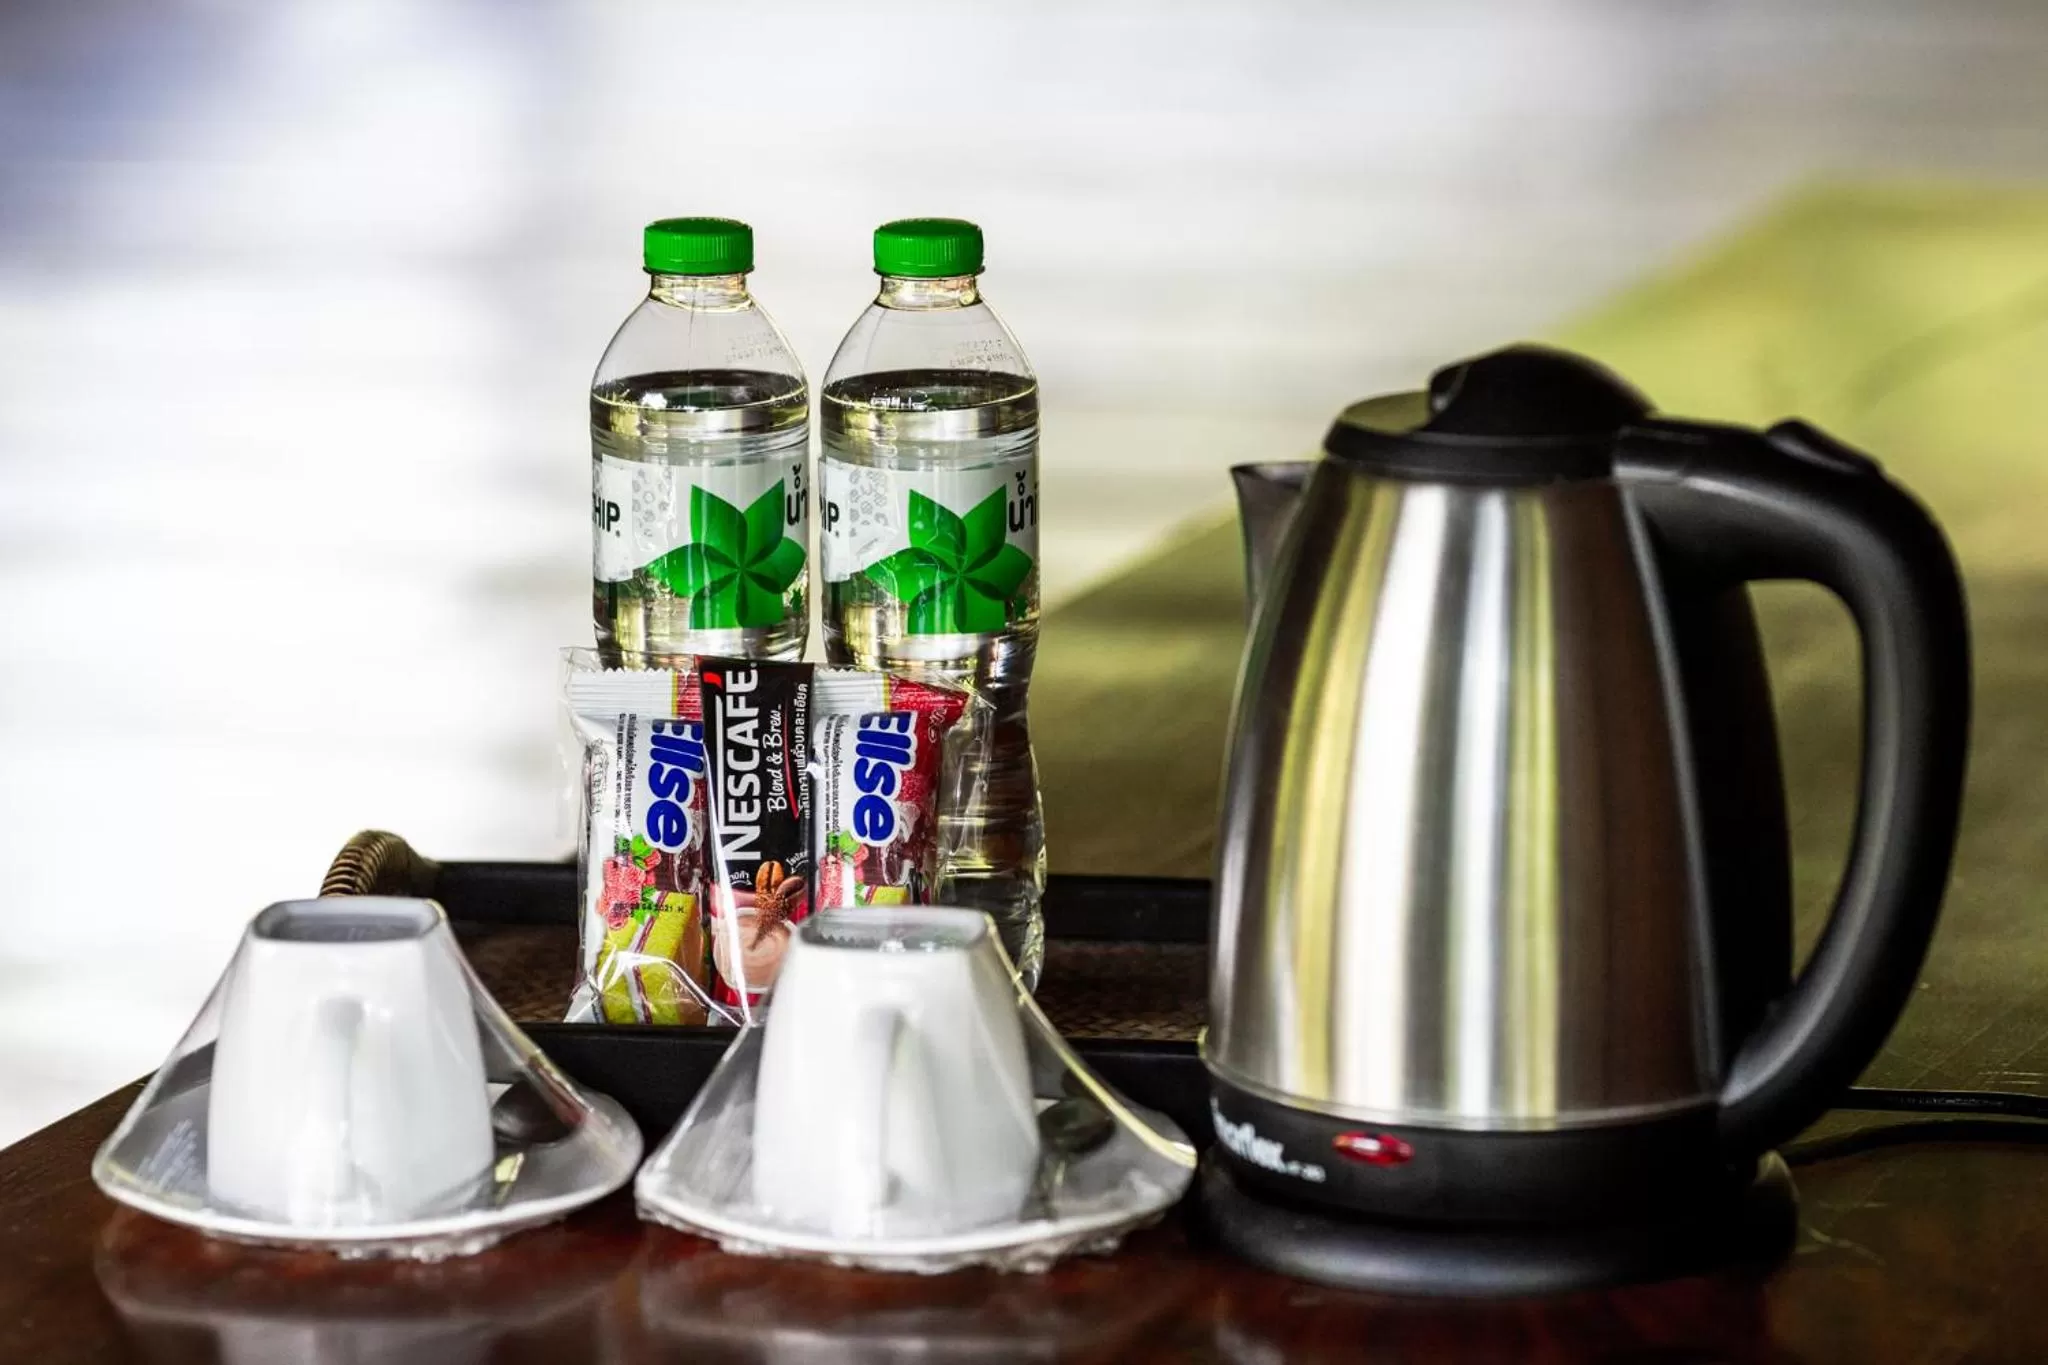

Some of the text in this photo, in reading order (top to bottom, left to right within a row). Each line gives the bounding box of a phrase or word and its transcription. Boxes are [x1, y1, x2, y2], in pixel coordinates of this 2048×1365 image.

[646, 719, 705, 848] Ellse
[762, 708, 788, 813] Blend & Brew
[852, 711, 912, 841] Ellse
